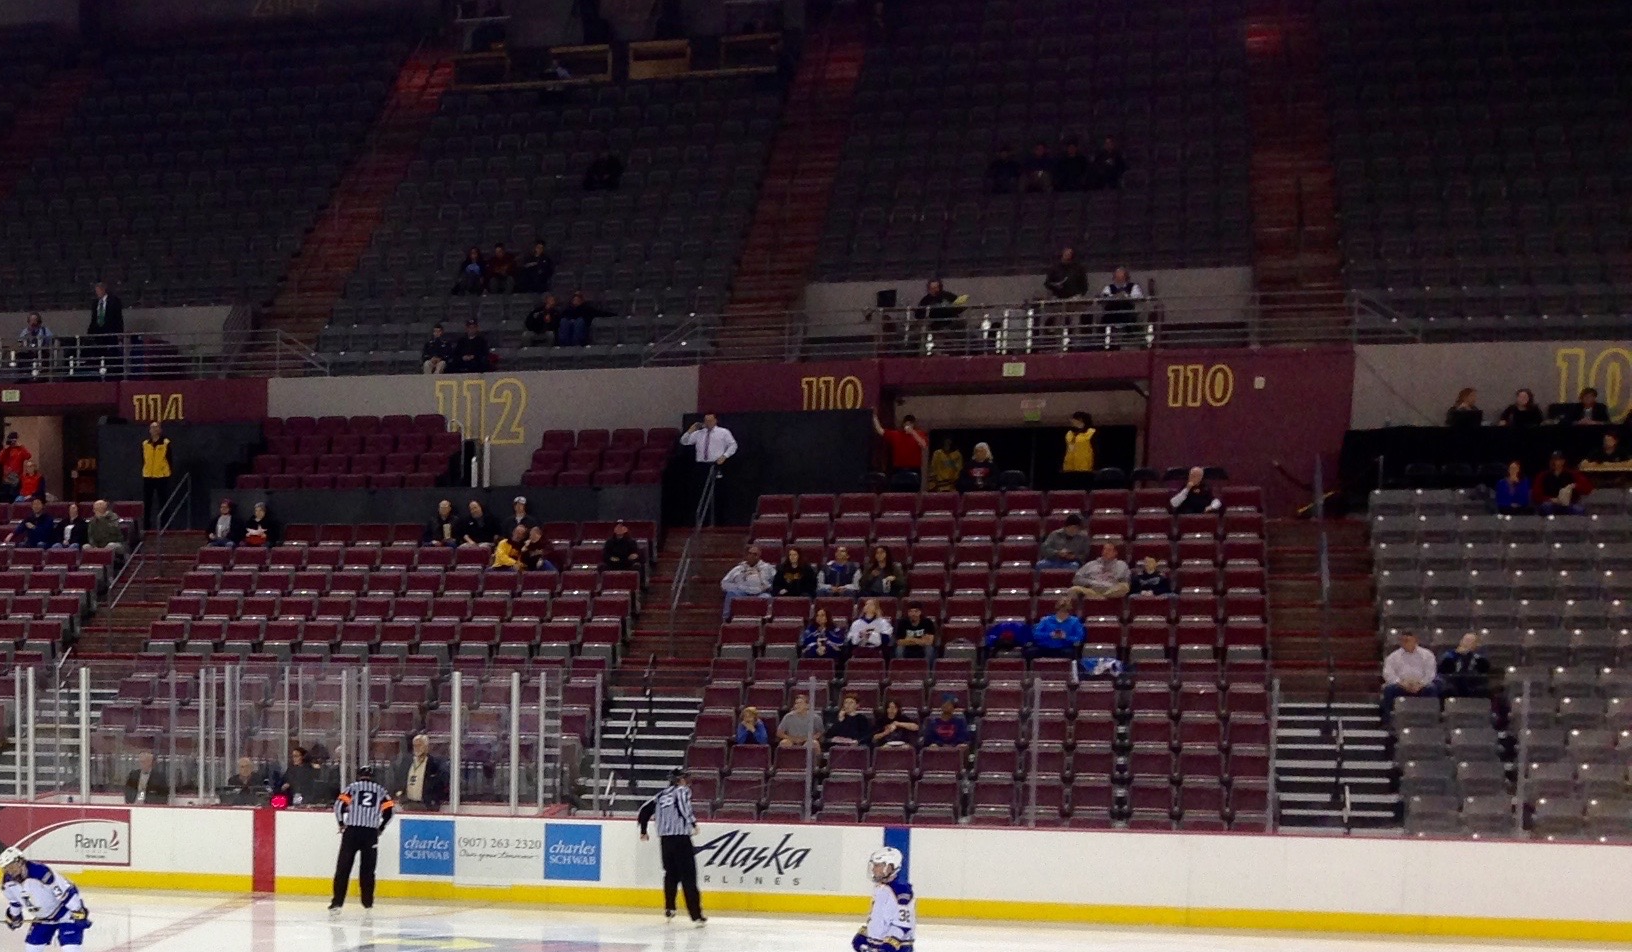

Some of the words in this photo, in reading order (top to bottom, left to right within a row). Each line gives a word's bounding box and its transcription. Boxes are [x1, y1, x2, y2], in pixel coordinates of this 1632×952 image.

[801, 375, 864, 411] 110
[1167, 363, 1234, 408] 110
[132, 393, 184, 422] 114
[435, 377, 528, 445] 112
[362, 791, 373, 806] 2
[74, 833, 108, 849] Ravn
[404, 836, 450, 850] charles
[457, 837, 487, 849] (907)
[549, 840, 596, 855] charles
[403, 850, 450, 861] SCHWAB
[693, 829, 812, 875] Alaska
[549, 855, 597, 866] SCHWAB
[704, 875, 802, 886] RLINES
